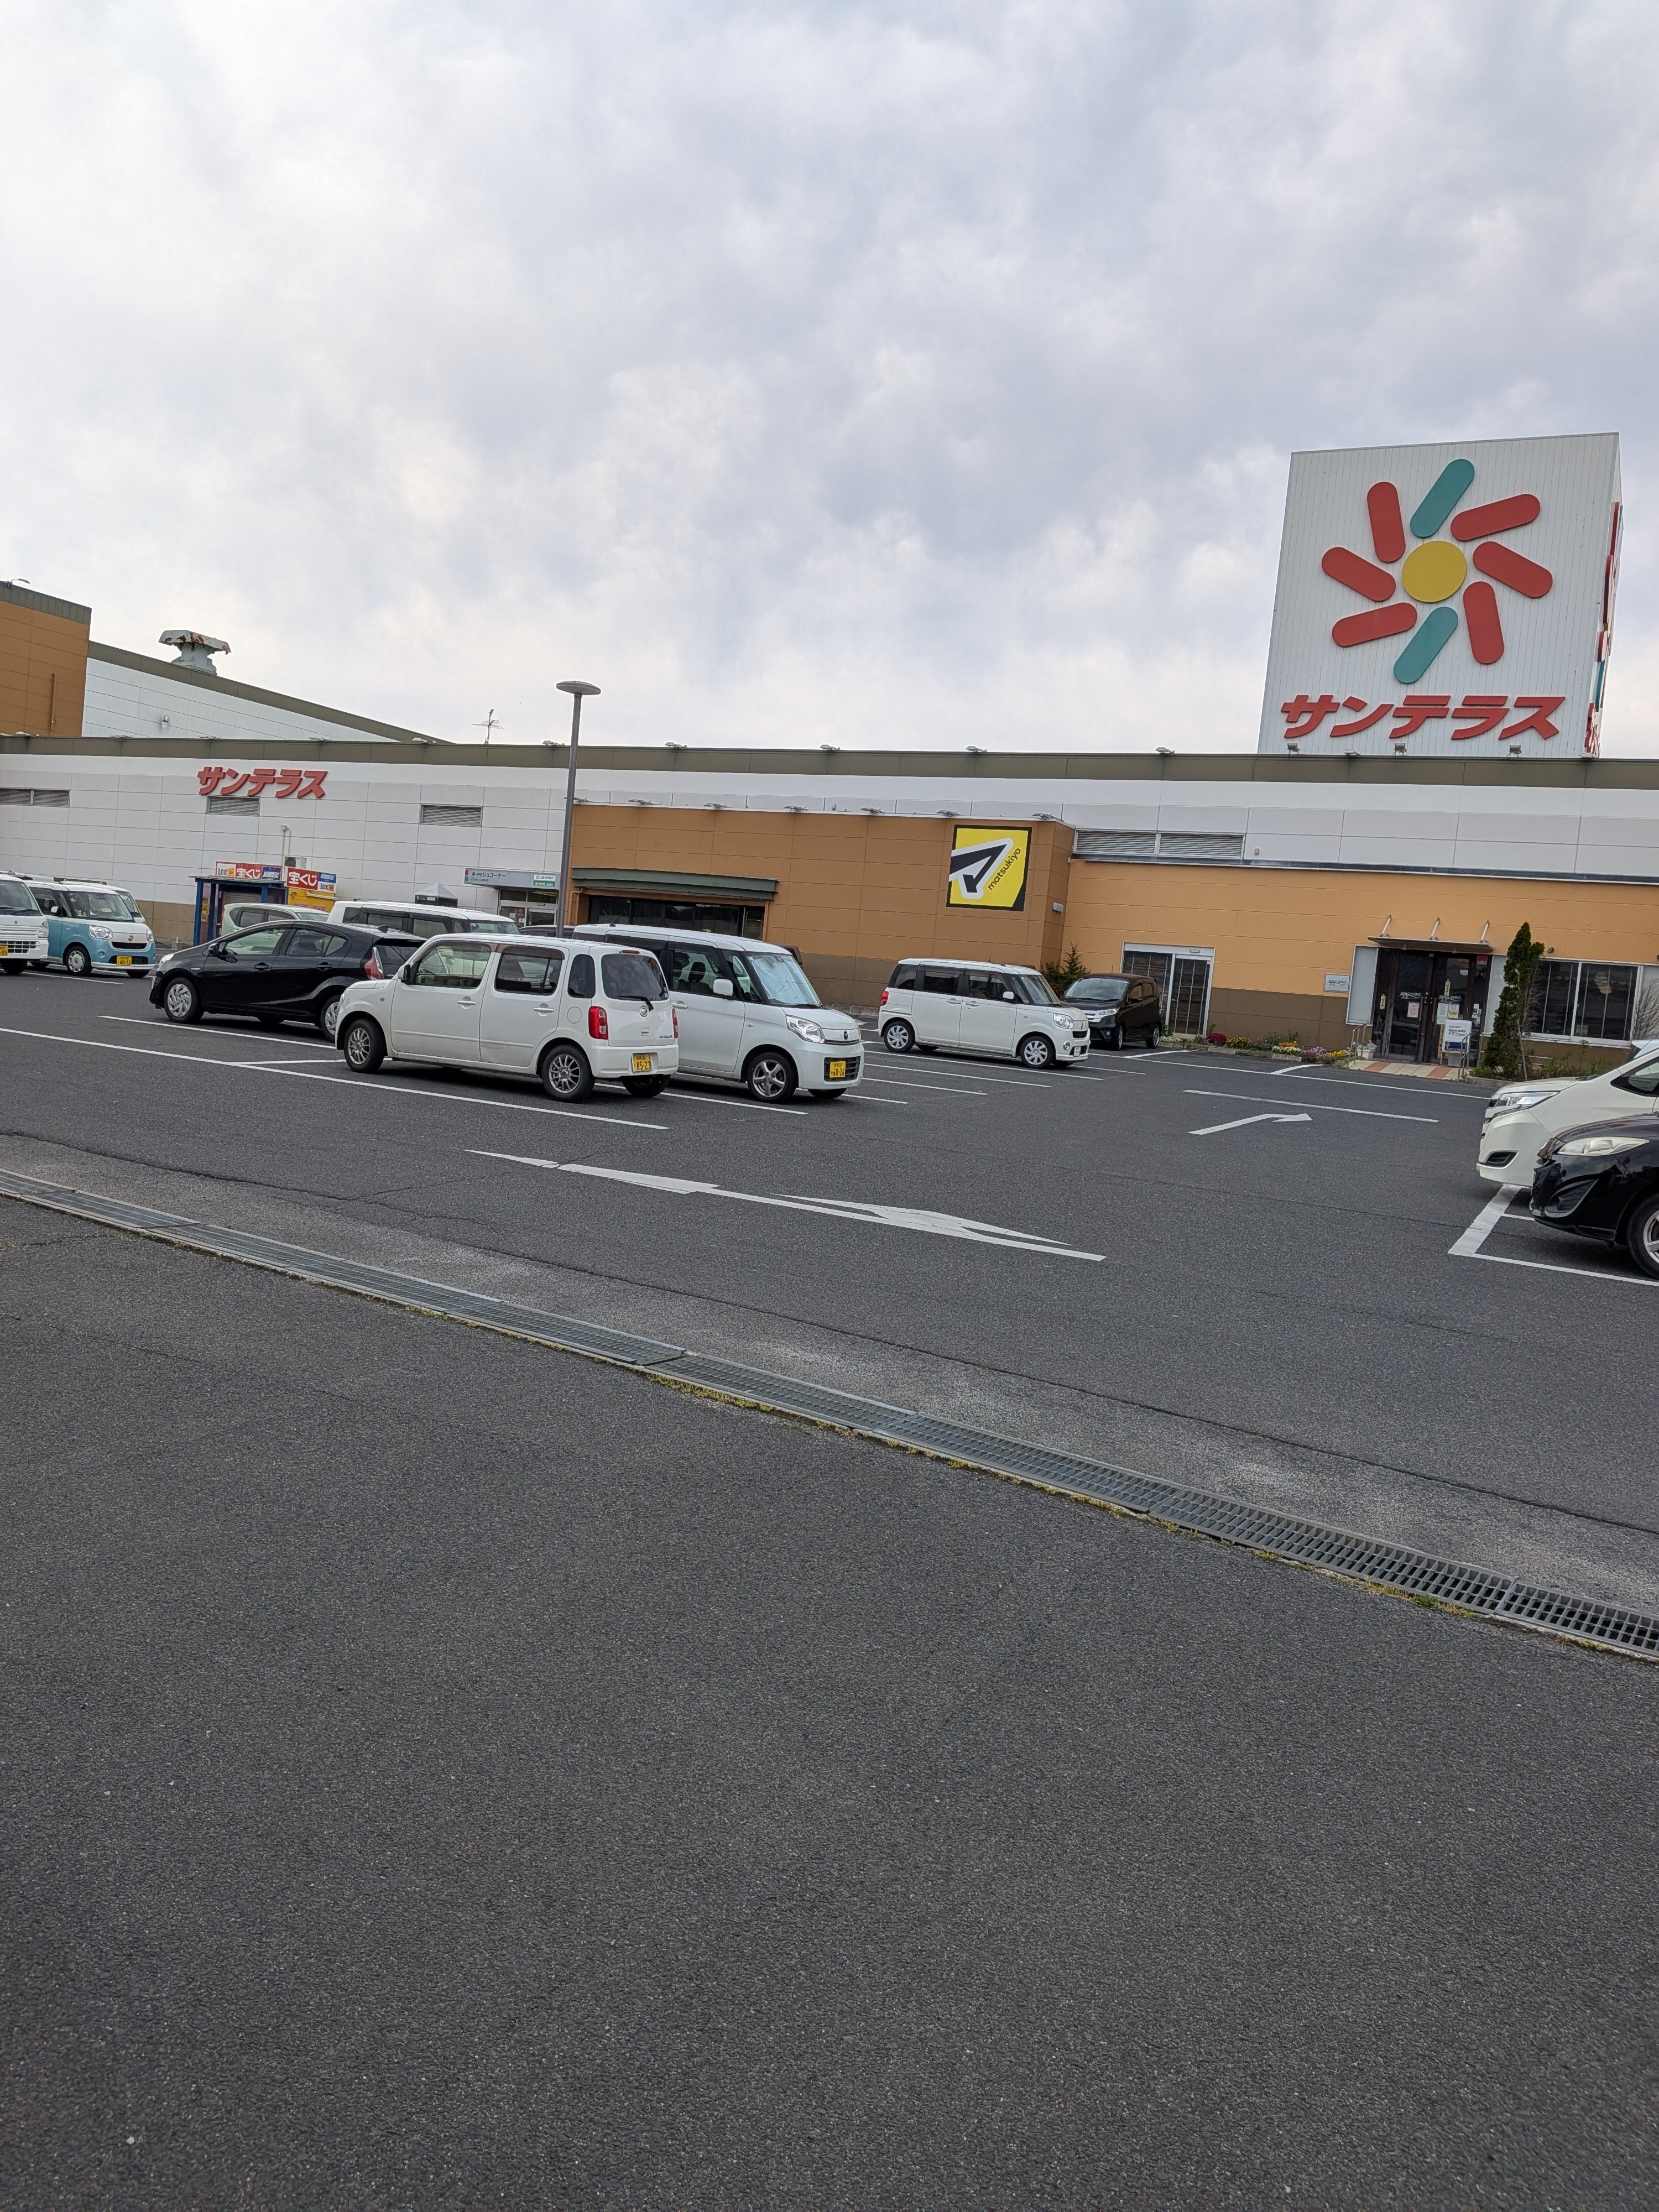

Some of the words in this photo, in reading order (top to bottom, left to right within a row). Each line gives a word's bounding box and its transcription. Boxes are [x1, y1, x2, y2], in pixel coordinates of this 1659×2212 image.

[1281, 695, 1566, 740] サンテラス
[197, 766, 328, 799] サンテラス
[237, 868, 260, 878] 宝くじ
[988, 848, 1021, 890] matsukiyo
[289, 872, 317, 886] 宝くじ
[637, 1061, 651, 1071] 85-23
[833, 1068, 845, 1076] 60-26
